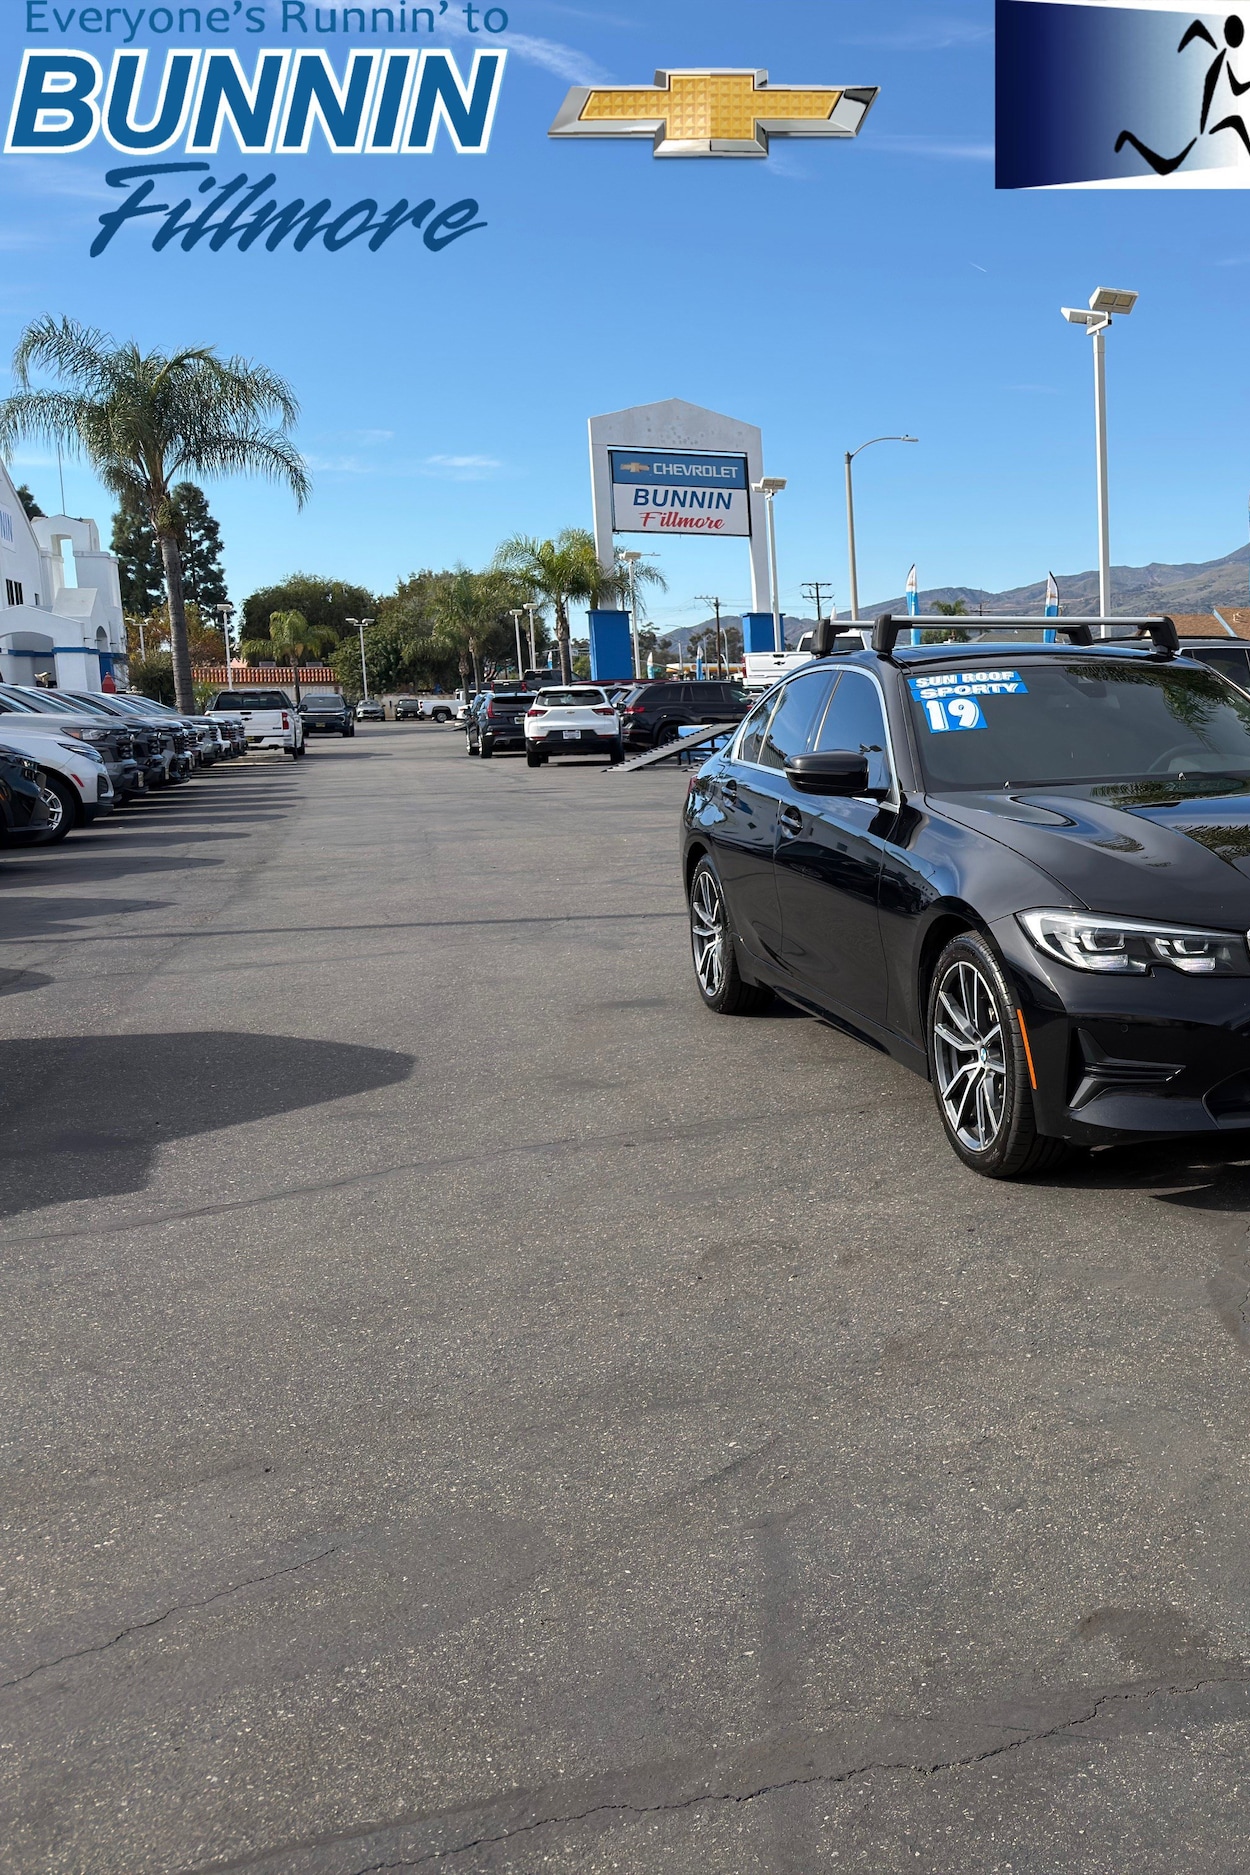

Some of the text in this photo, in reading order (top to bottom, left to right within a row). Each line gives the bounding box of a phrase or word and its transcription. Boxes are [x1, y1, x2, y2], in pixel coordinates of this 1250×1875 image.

[653, 462, 738, 479] CHEVROLET
[633, 488, 732, 510] BUNNIN
[639, 511, 725, 530] Fillmore
[916, 670, 1015, 689] SUN ROOF
[920, 683, 1018, 700] SPORTY
[926, 698, 979, 731] 19
